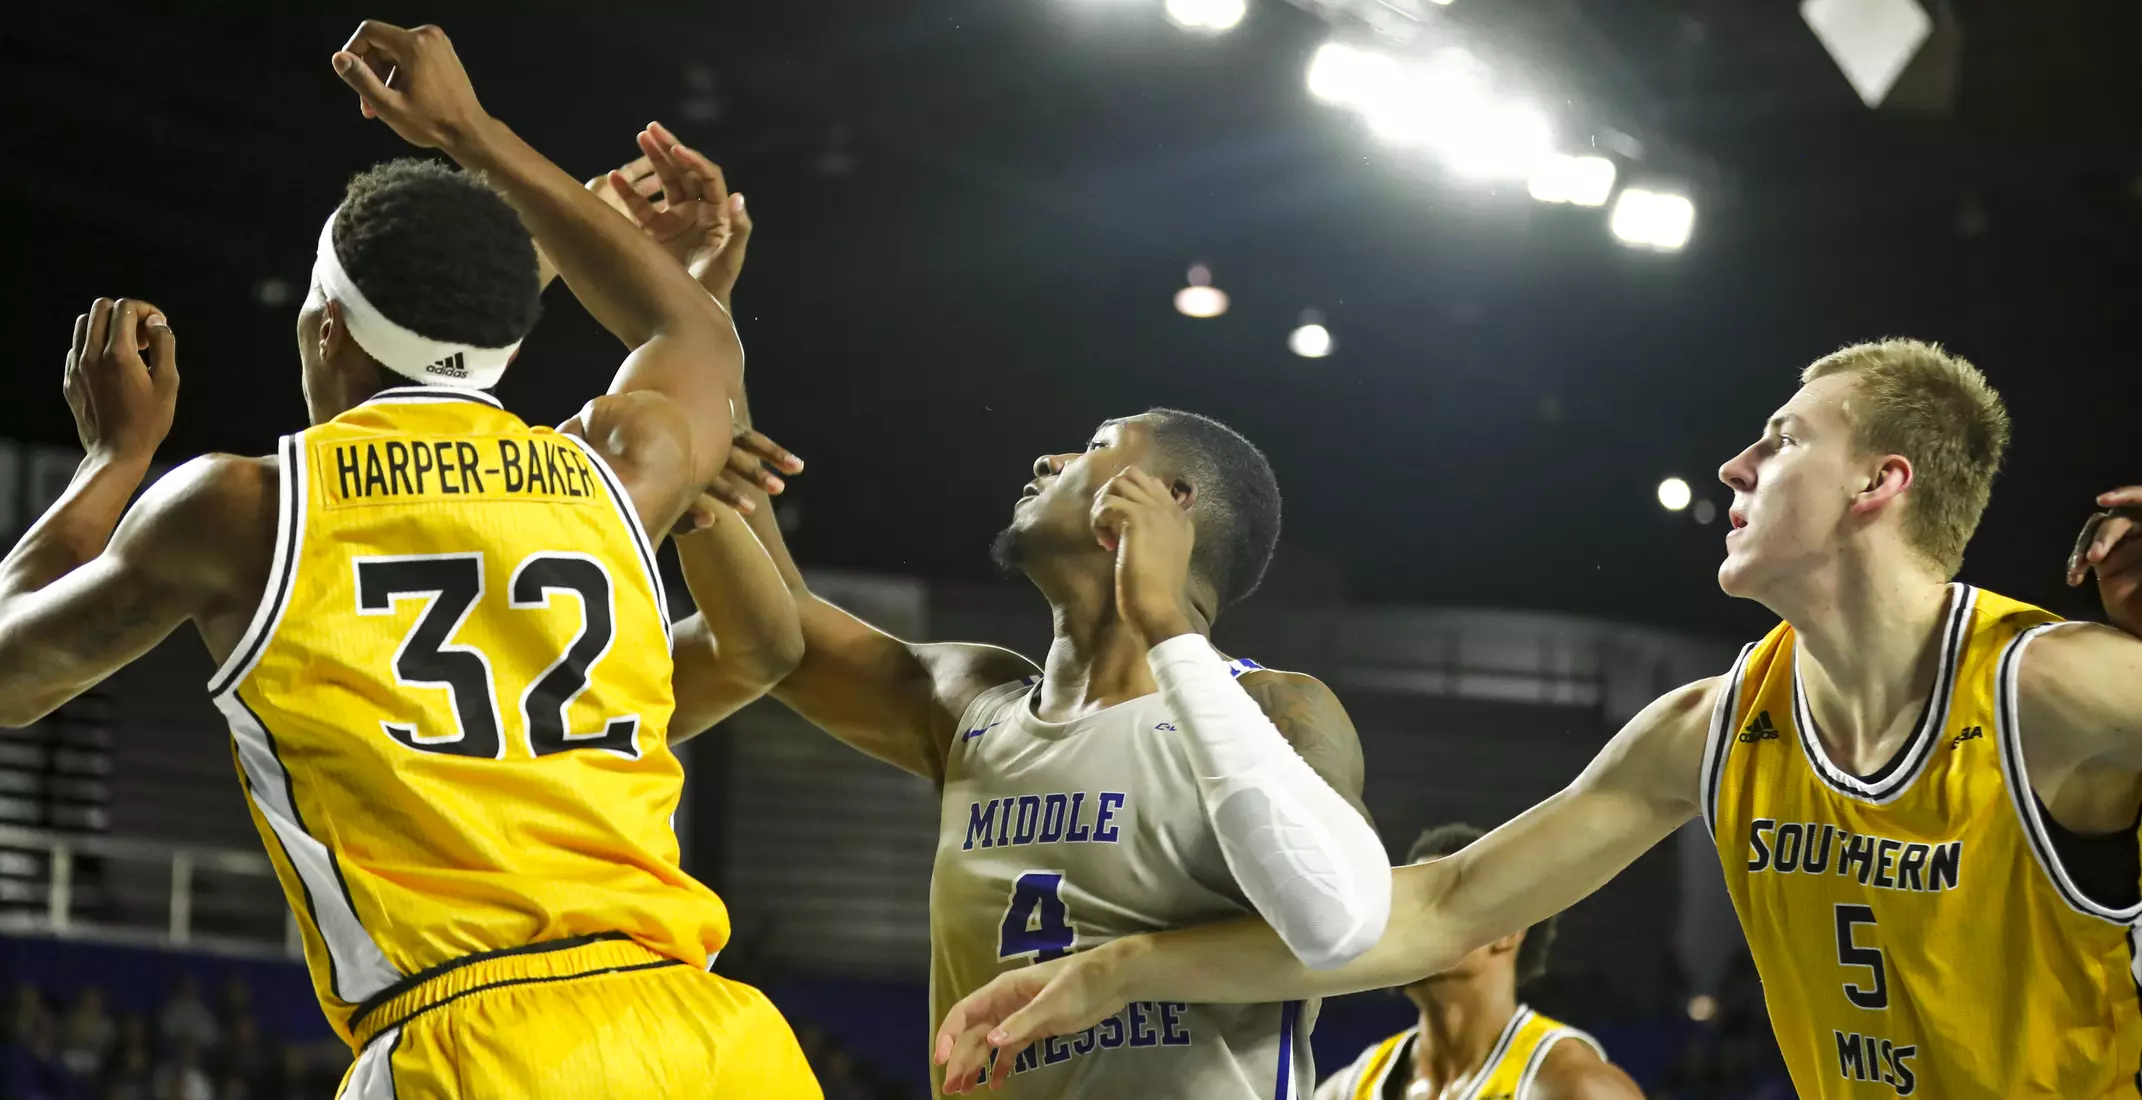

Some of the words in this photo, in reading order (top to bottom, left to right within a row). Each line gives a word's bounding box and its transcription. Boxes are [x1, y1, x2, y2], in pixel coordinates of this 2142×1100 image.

[426, 364, 468, 379] adidas
[336, 439, 596, 499] HARPER-BAKER
[352, 550, 643, 761] 32
[962, 792, 1126, 852] MIDDLE
[1748, 818, 1963, 892] SOUTHERN
[997, 869, 1079, 966] 4
[1834, 903, 1888, 1010] 5
[960, 1001, 1192, 1086] NESSEE
[1832, 1029, 1917, 1096] MISS
